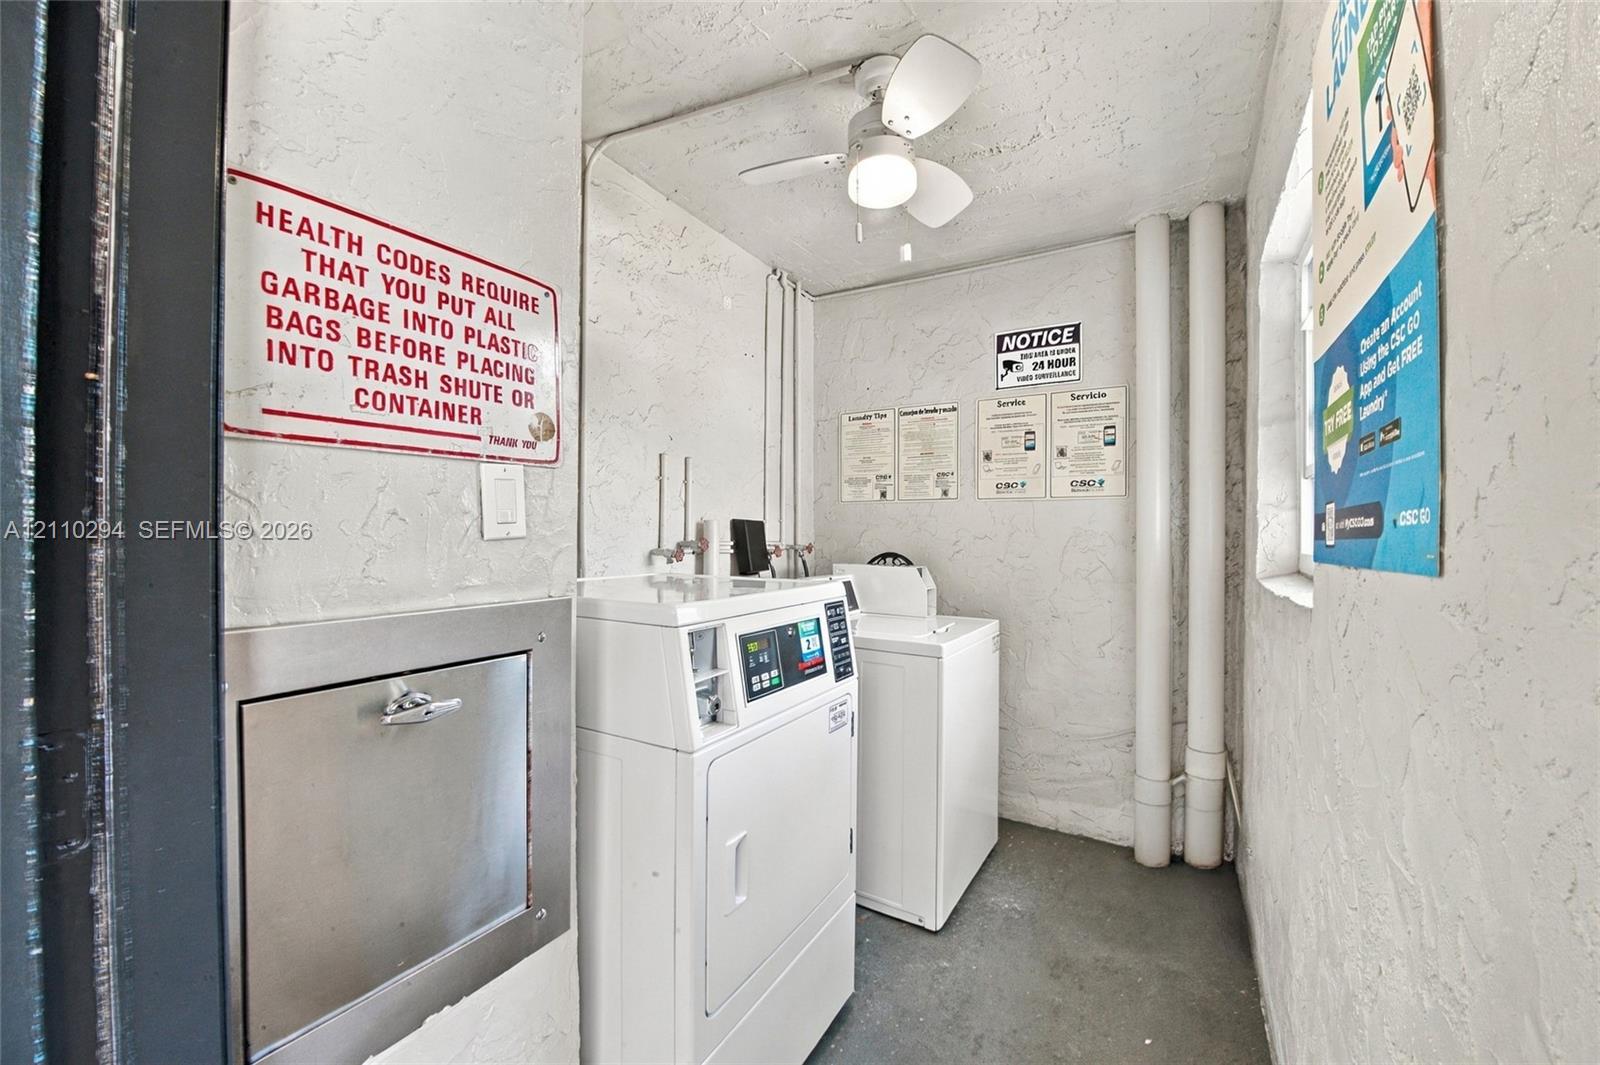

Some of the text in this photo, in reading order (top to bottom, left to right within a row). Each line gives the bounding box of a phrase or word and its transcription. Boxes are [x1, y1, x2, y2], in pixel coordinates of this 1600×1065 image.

[256, 200, 540, 315] HEALTH CODES REQUIRE
[301, 248, 516, 332] THAT YOU PUT ALL
[260, 270, 538, 362] GARBAGE INTO PLASTIC
[1360, 280, 1423, 354] Create an Account
[265, 304, 535, 386] BAGS BEFORE PLACING
[1001, 327, 1075, 352] NOTICE
[1034, 350, 1048, 358] AREA
[1360, 310, 1420, 377] Using the CSC GO
[266, 338, 535, 410] INTO TRASH SHUTE OR
[1017, 370, 1077, 382] VIDEO SURVEILLANCE
[1032, 357, 1076, 371] 24 HOUR
[1360, 380, 1373, 400] App
[1373, 366, 1386, 390] and
[1387, 355, 1401, 378] Get
[1401, 334, 1423, 369] FREE
[354, 387, 483, 426] CONTAINER
[996, 398, 1026, 408] Service
[1070, 391, 1107, 401] Servicio
[1324, 415, 1336, 437] TRY
[1335, 400, 1353, 430] FREE
[488, 435, 538, 451] THANK YOU
[1070, 479, 1096, 488] CSC
[1400, 506, 1431, 527] CSC GO
